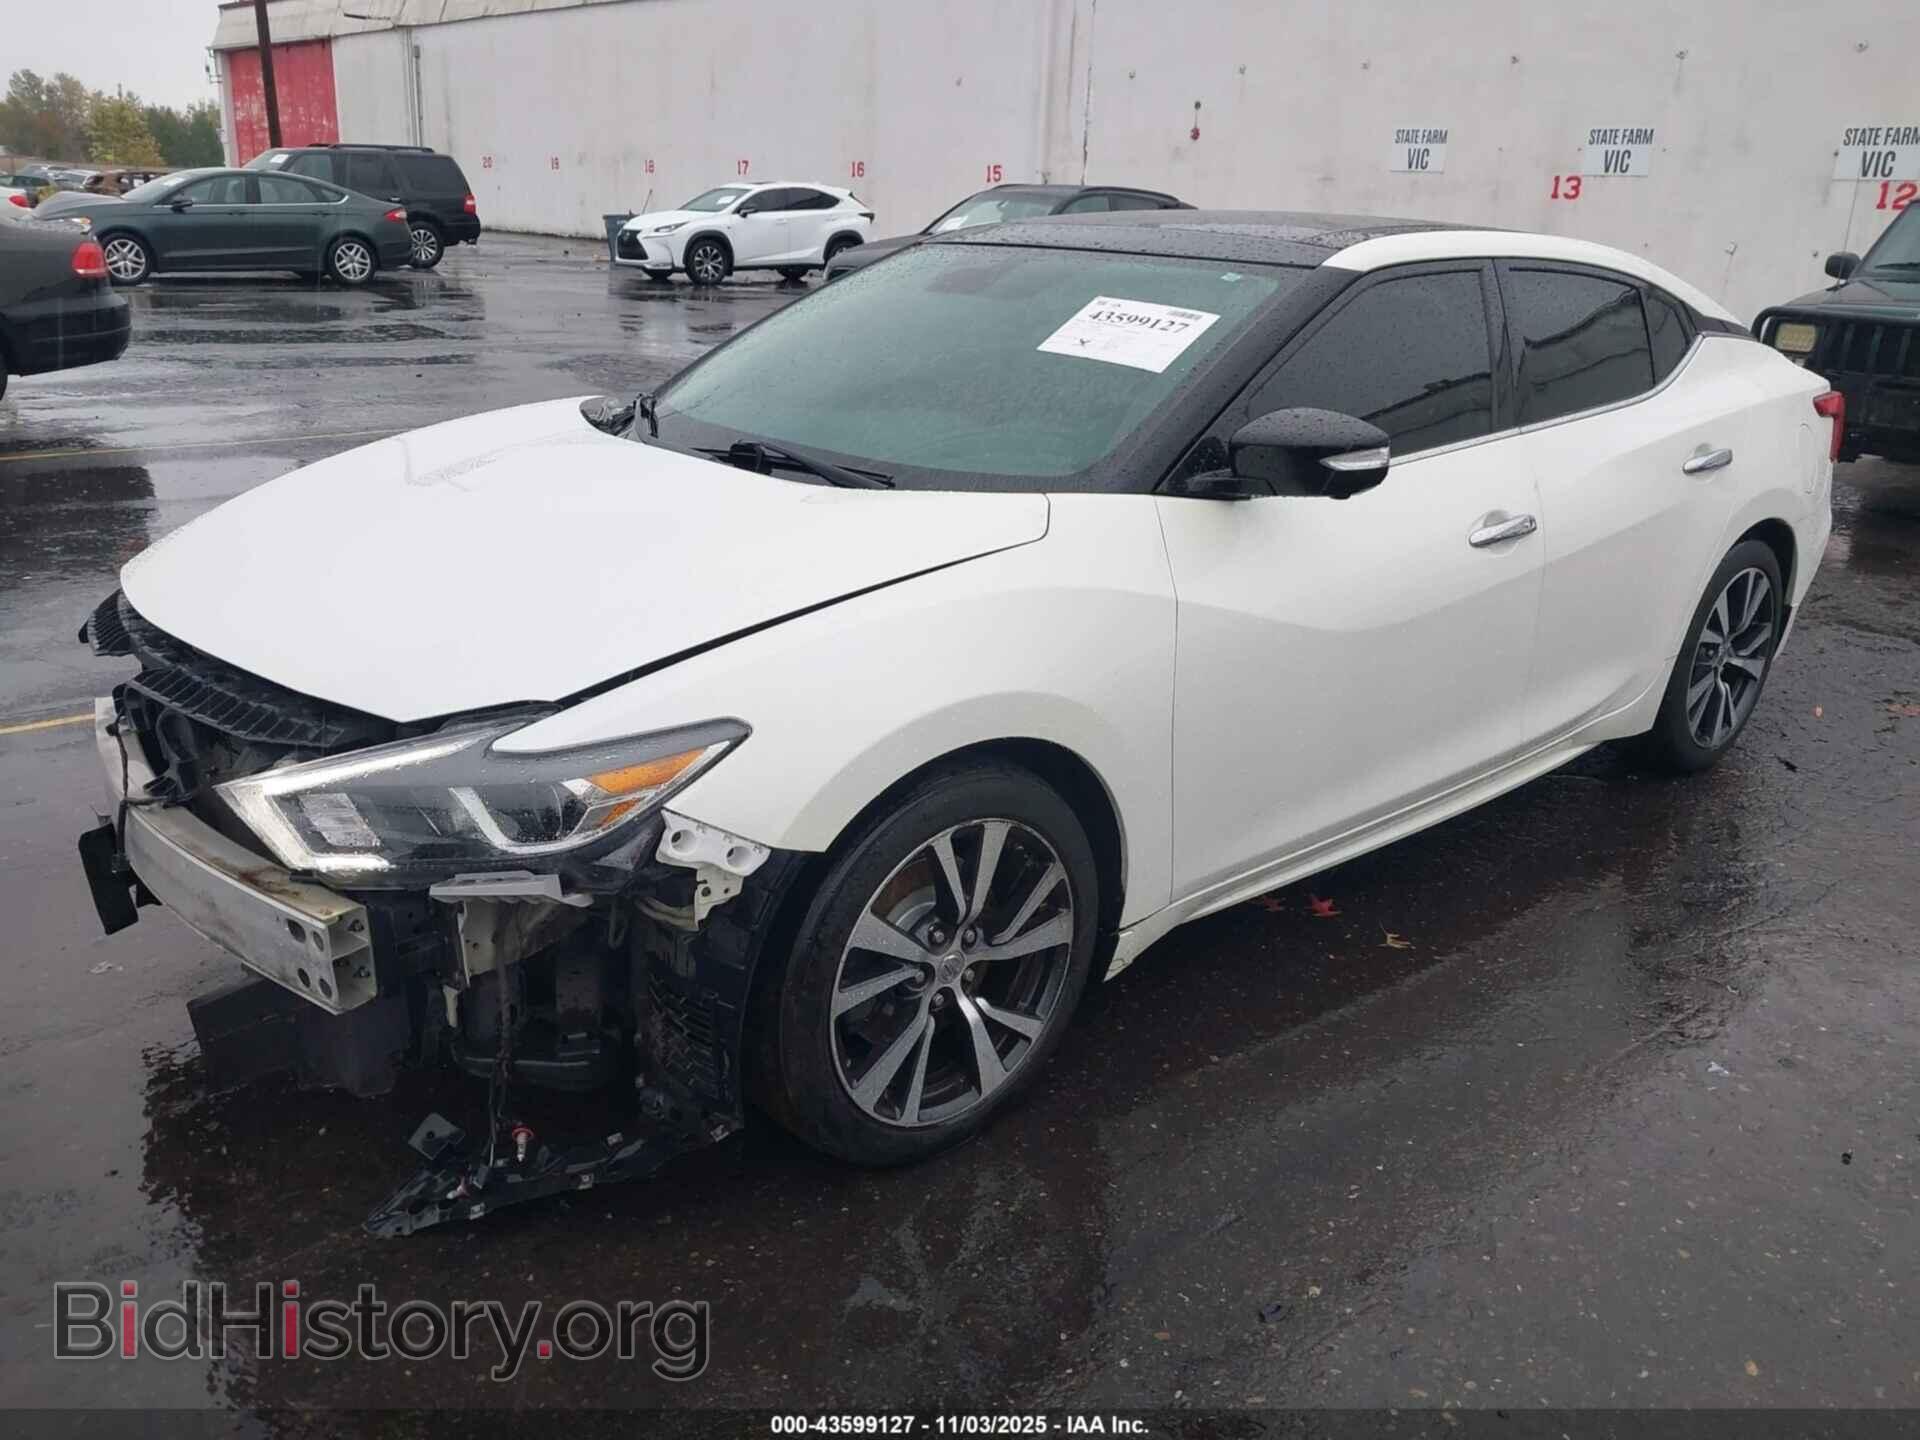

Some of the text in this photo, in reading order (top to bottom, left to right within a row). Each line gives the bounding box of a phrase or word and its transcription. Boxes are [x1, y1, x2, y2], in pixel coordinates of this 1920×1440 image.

[1394, 128, 1449, 145] STATE FARM
[1588, 128, 1655, 145] STATE FARM
[1843, 127, 1882, 146] STATE
[737, 160, 750, 175] 17
[1407, 147, 1430, 170] VIC
[1603, 149, 1632, 174] VIC
[1861, 150, 1897, 178] VIC
[851, 161, 865, 178] 16
[986, 164, 1002, 183] 15
[1551, 175, 1582, 201] 13
[1876, 180, 1918, 210] 12
[1088, 309, 1190, 334] 43599127
